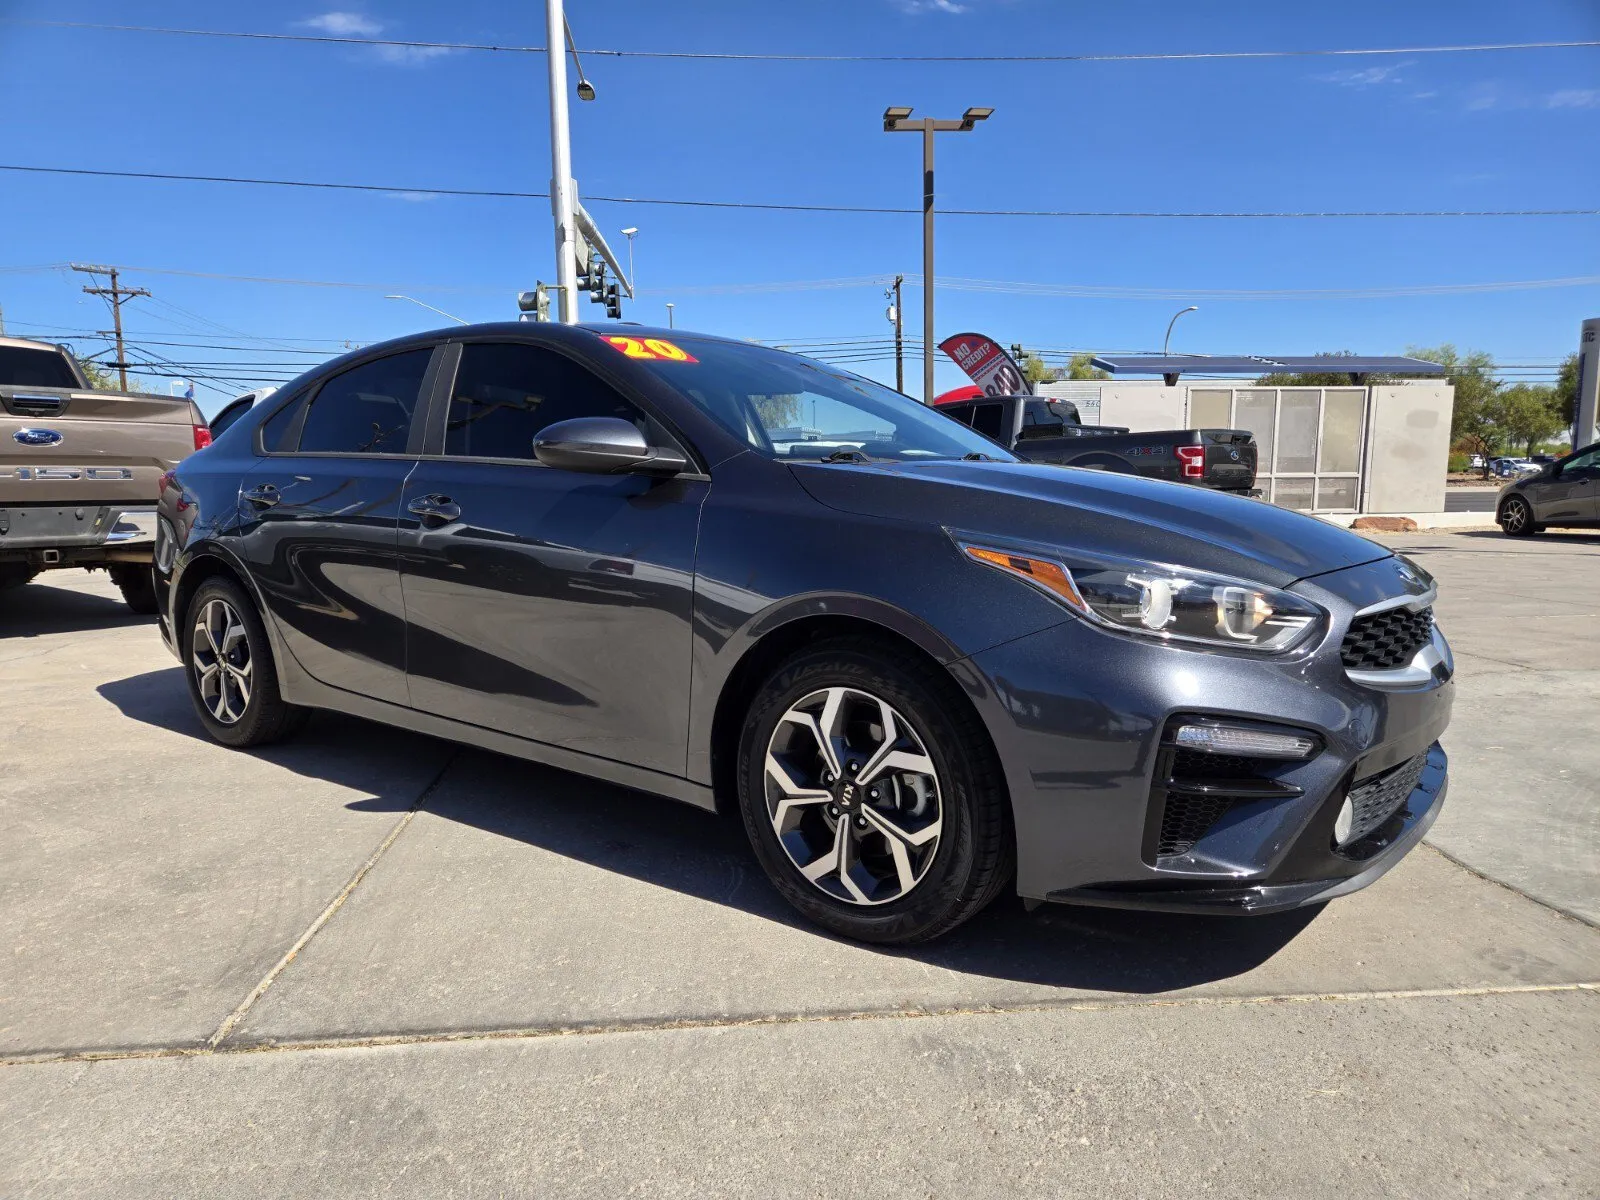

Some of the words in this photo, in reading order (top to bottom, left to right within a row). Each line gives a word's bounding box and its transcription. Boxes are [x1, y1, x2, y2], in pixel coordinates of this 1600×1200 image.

[610, 337, 687, 361] 20
[953, 342, 971, 361] NO
[961, 342, 990, 370] CREDIT?
[841, 784, 854, 805] KIA
